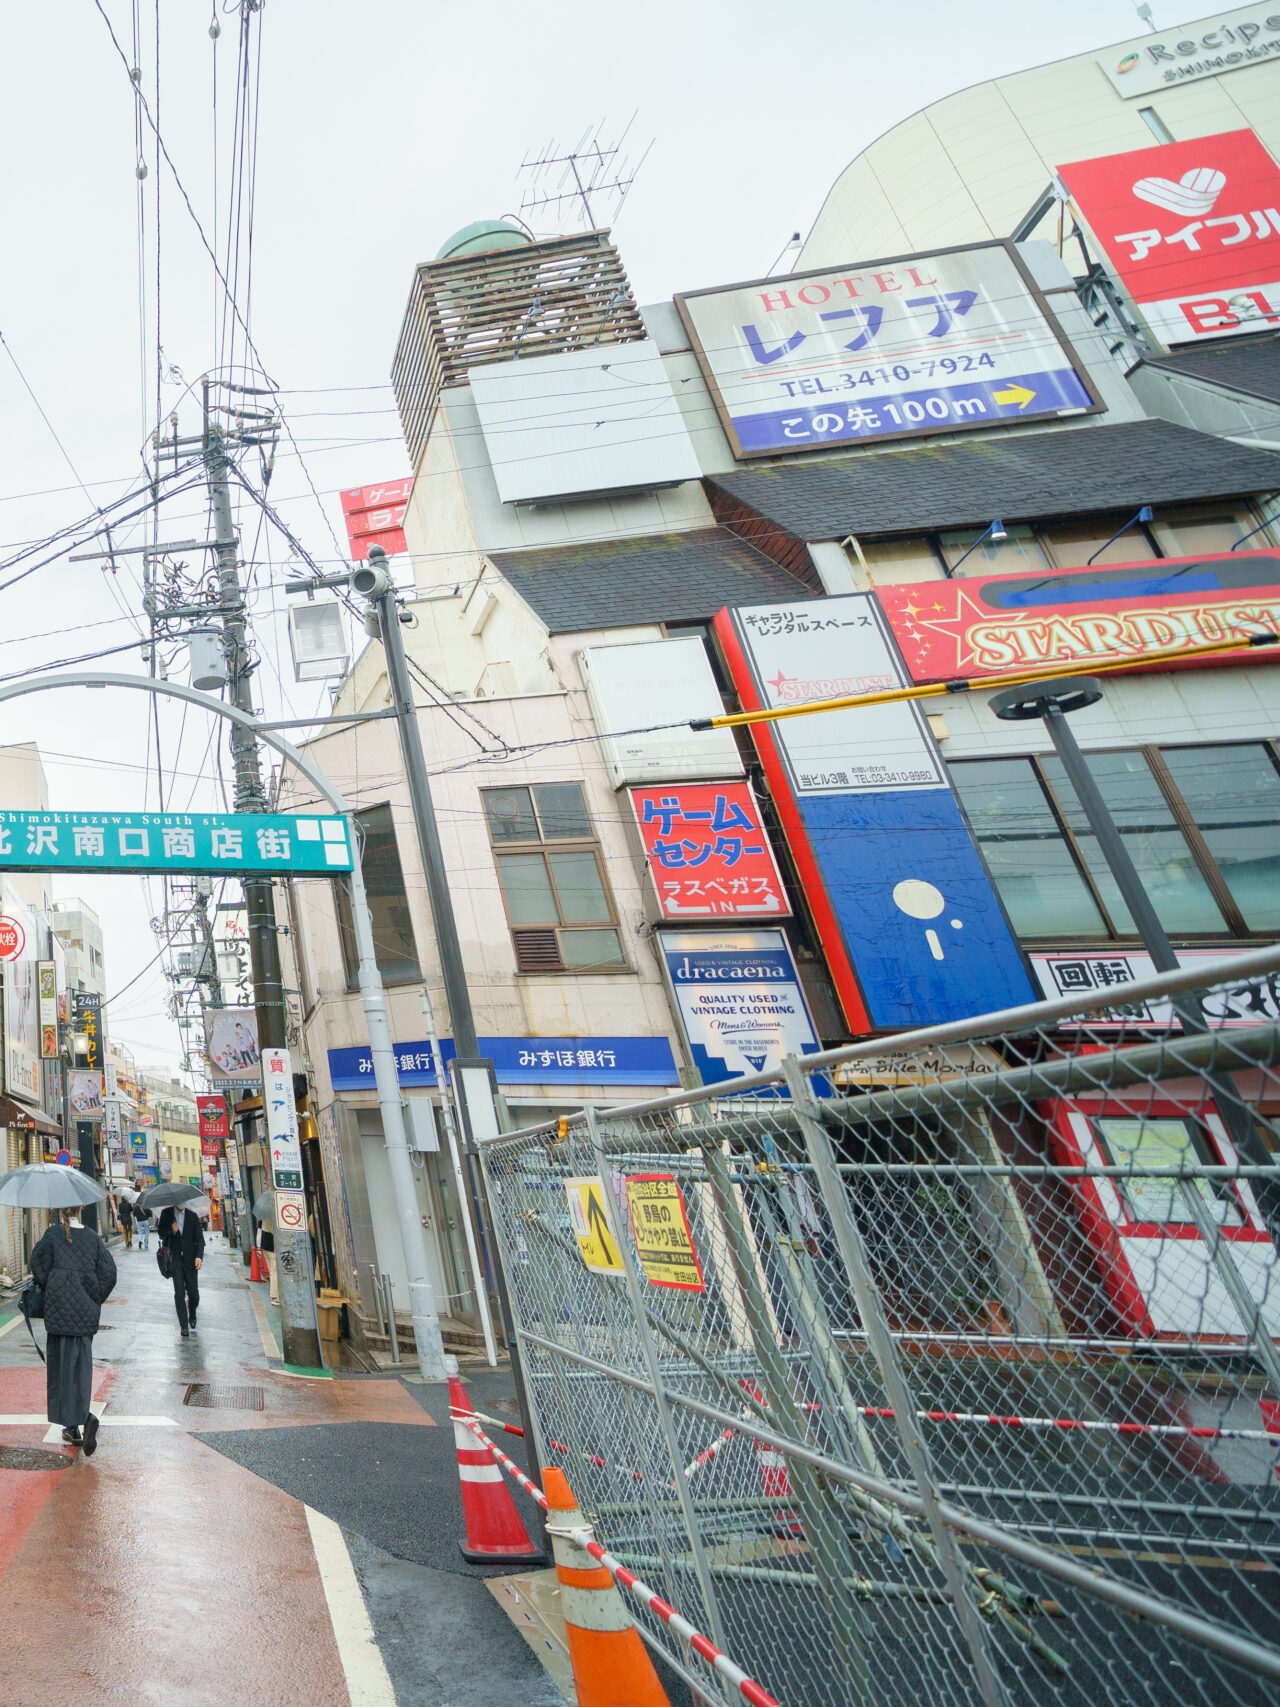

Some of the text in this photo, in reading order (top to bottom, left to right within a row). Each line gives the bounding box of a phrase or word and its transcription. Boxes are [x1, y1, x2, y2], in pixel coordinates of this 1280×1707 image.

[757, 266, 939, 313] HOTEL
[780, 352, 997, 399] TEL.3410-7924
[745, 612, 809, 627] ギャラリー
[778, 674, 893, 702] STARDUST
[800, 772, 850, 787] 当ビル3階
[142, 815, 193, 826] South
[202, 816, 226, 827] st.
[641, 795, 756, 836] ゲーム
[653, 836, 764, 868] センター
[663, 876, 775, 896] ラスベガス
[710, 899, 735, 914] IN
[677, 957, 786, 979] dracaena
[78, 996, 99, 1007] 24H
[699, 995, 778, 1004] QUALITY USED
[691, 1006, 795, 1015] VINTAGE CLOTHING
[270, 1059, 284, 1073] 質
[358, 1053, 431, 1073] み銀行
[518, 1050, 617, 1068] みずほ銀行
[643, 1204, 671, 1223] 野鳥の
